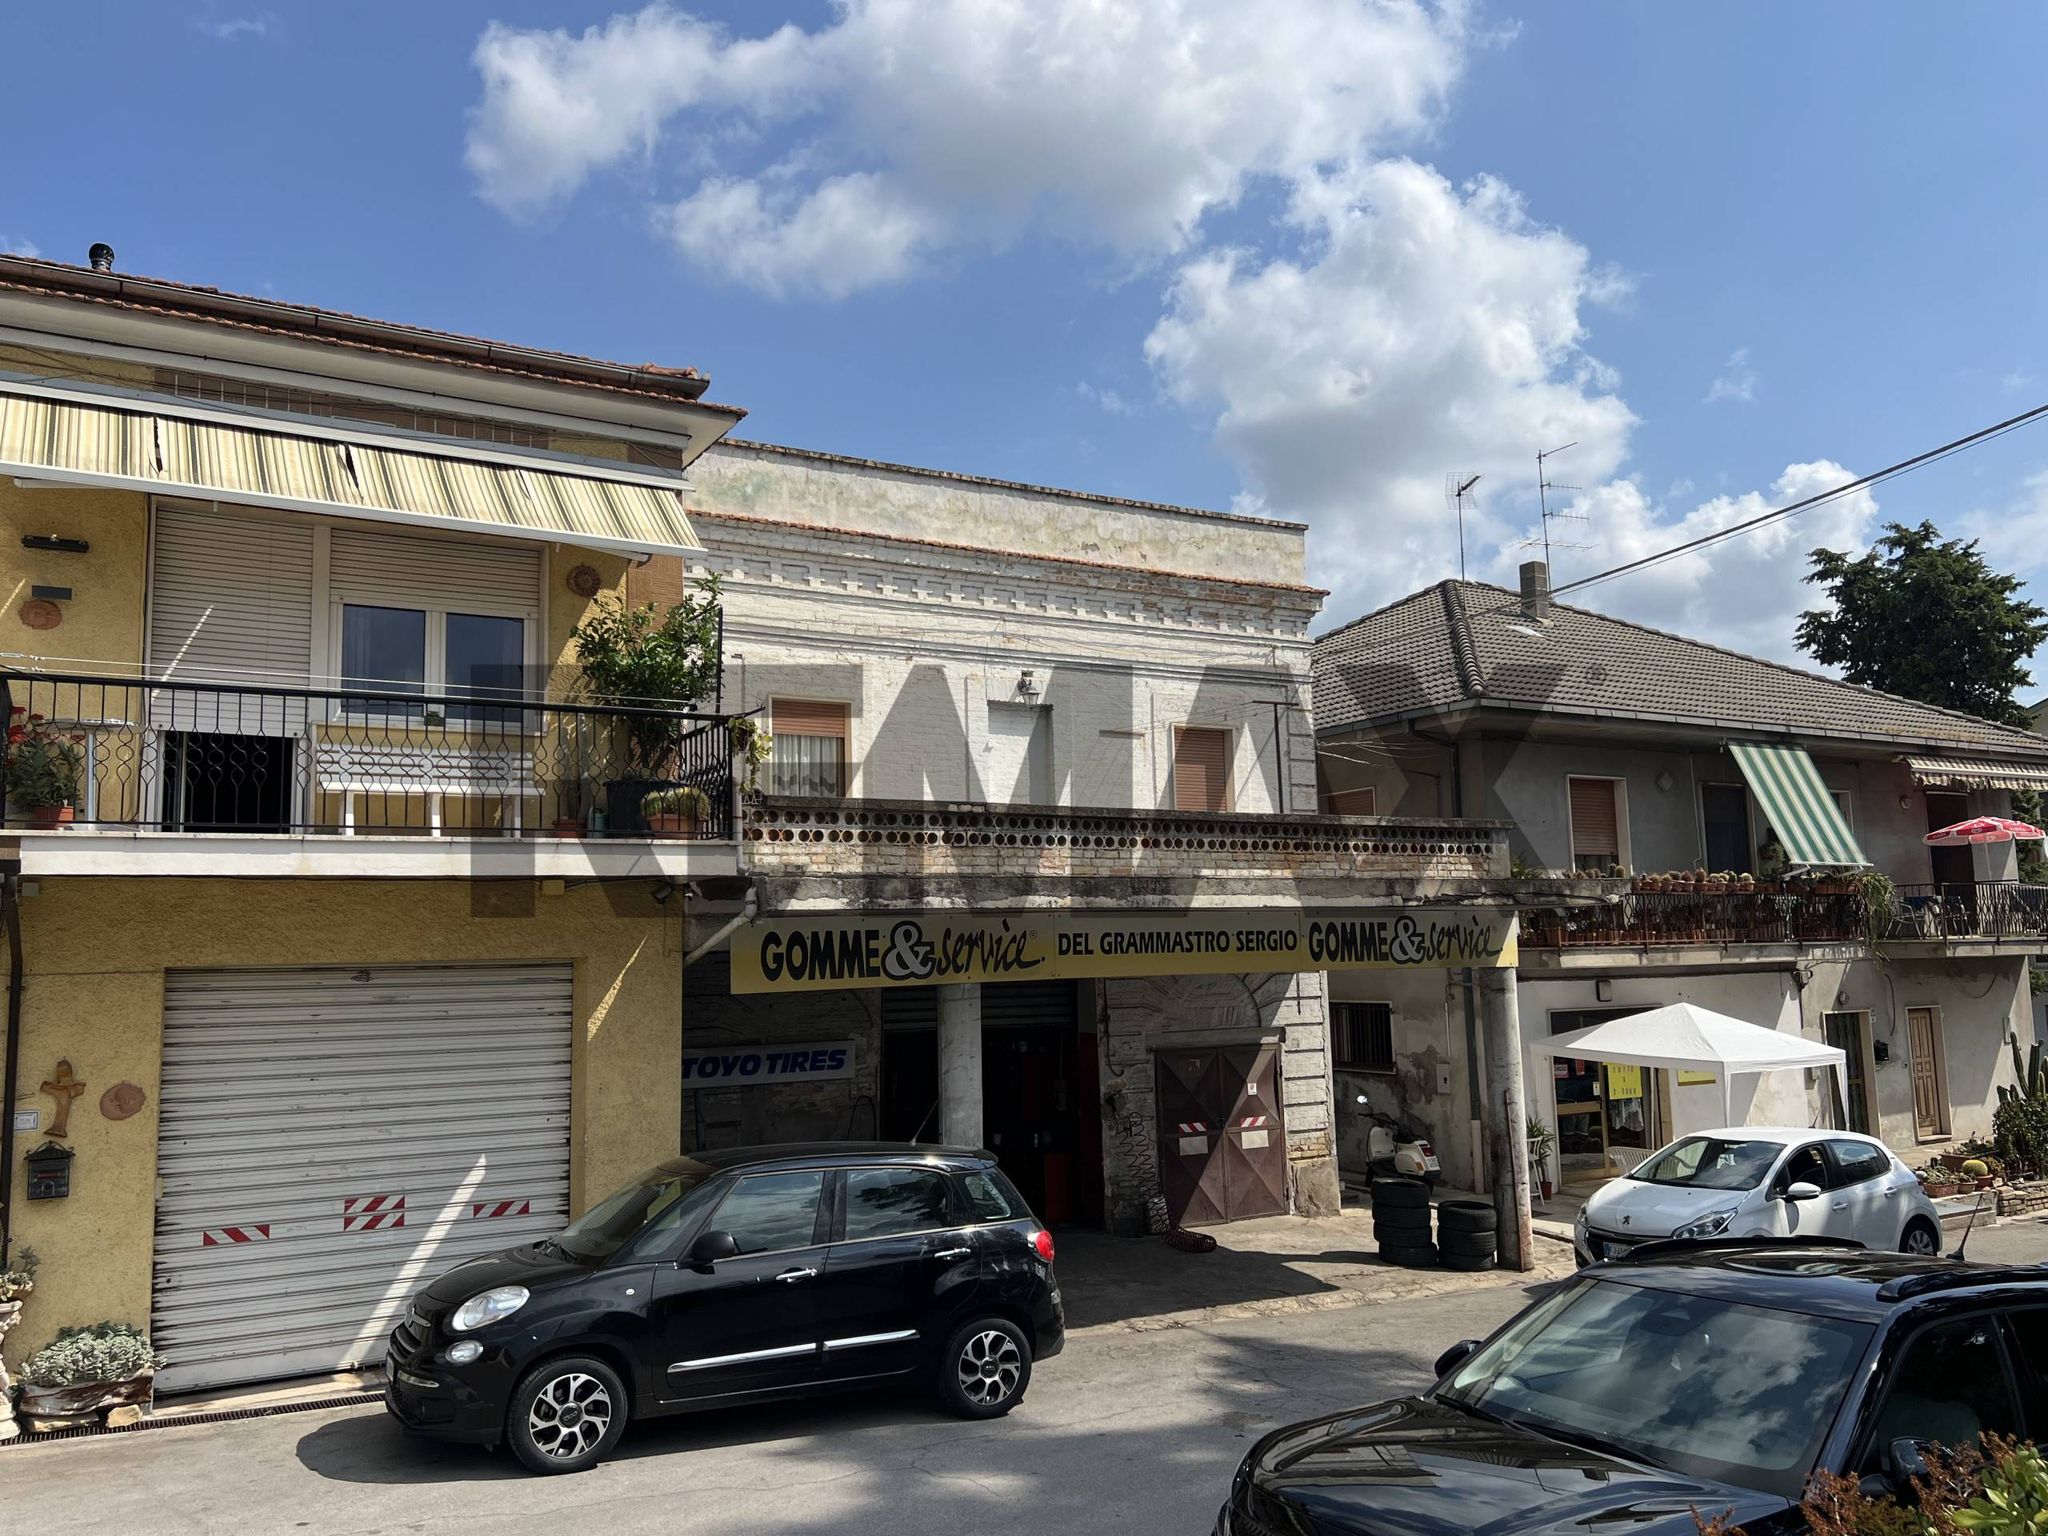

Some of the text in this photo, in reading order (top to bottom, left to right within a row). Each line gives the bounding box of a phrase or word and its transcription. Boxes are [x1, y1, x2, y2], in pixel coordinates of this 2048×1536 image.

[761, 930, 881, 981] GOMME
[1058, 930, 1297, 955] DEL GRAMMASTRO SERGIO
[1308, 921, 1389, 962] GOMME
[681, 1050, 847, 1080] TOYO TIRES
